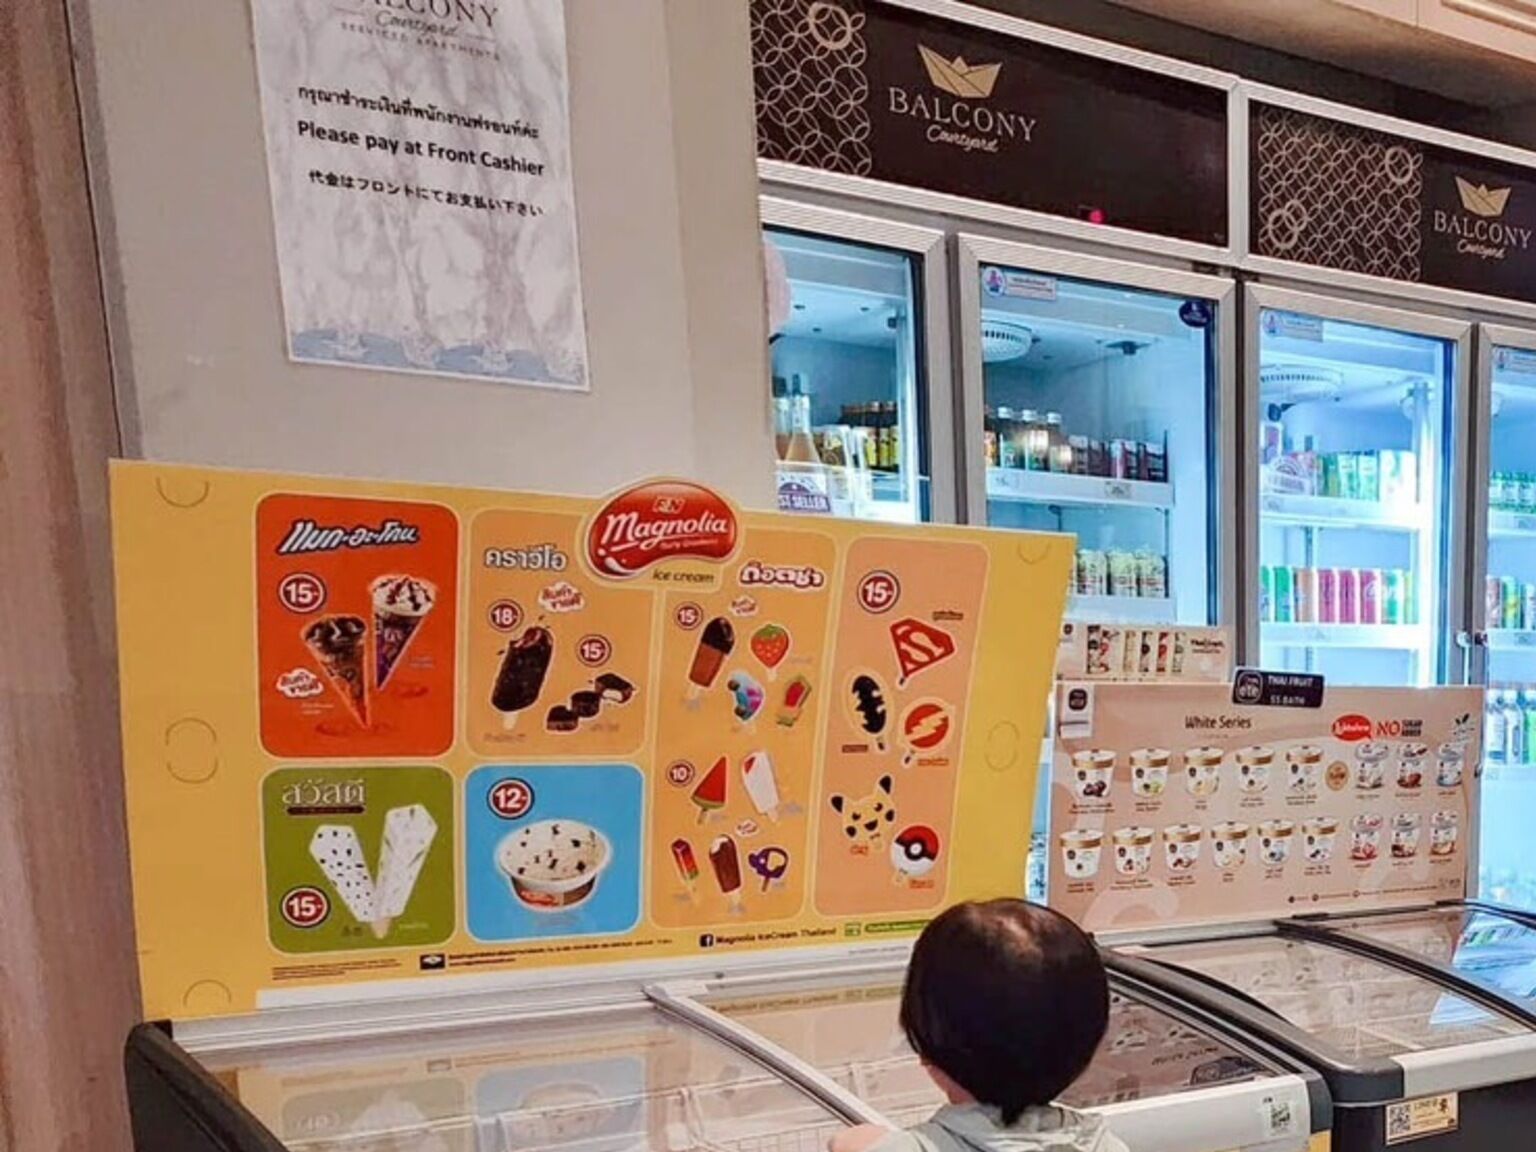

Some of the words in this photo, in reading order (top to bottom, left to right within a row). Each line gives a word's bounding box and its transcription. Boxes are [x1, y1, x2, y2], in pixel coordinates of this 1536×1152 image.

[888, 87, 1037, 142] BALCONY
[298, 120, 360, 146] Please
[366, 134, 398, 155] pay
[404, 141, 423, 157] at
[428, 142, 477, 166] Front
[480, 153, 545, 176] Cashier
[1433, 210, 1533, 249] BALCONY
[601, 510, 728, 550] Magnolia
[652, 569, 671, 581] ice
[673, 571, 715, 583] cream
[1184, 714, 1217, 729] White
[1219, 714, 1252, 729] Series
[1376, 719, 1401, 737] NO
